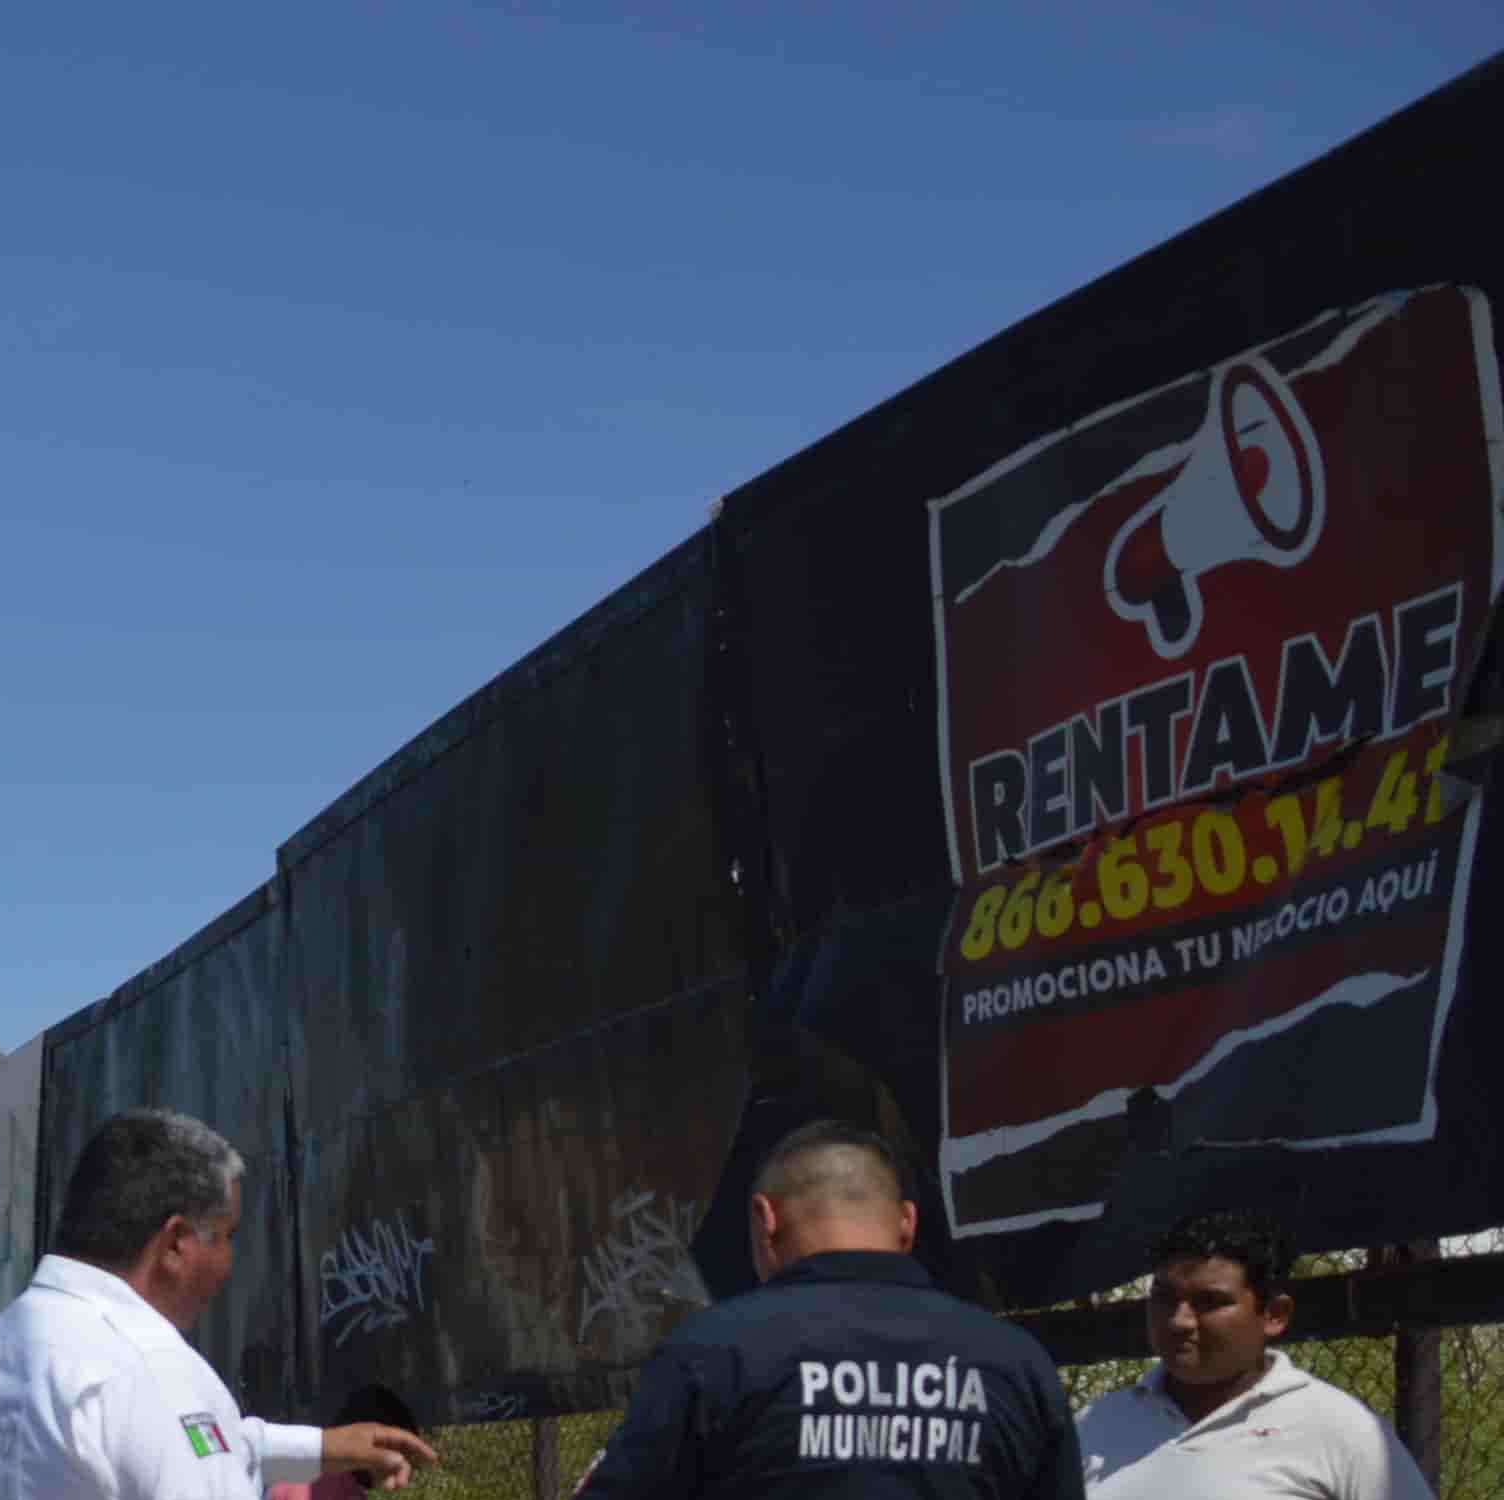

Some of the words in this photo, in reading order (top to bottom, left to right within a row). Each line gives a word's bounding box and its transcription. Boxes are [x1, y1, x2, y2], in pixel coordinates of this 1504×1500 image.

[968, 580, 1464, 875] RENTAME
[963, 946, 1167, 1024] PROMOCIONA
[1175, 933, 1222, 973] TU
[1354, 848, 1440, 914] AQUÍ
[798, 1413, 982, 1464] MUNICIPAL
[799, 1355, 988, 1413] POLICÍA
